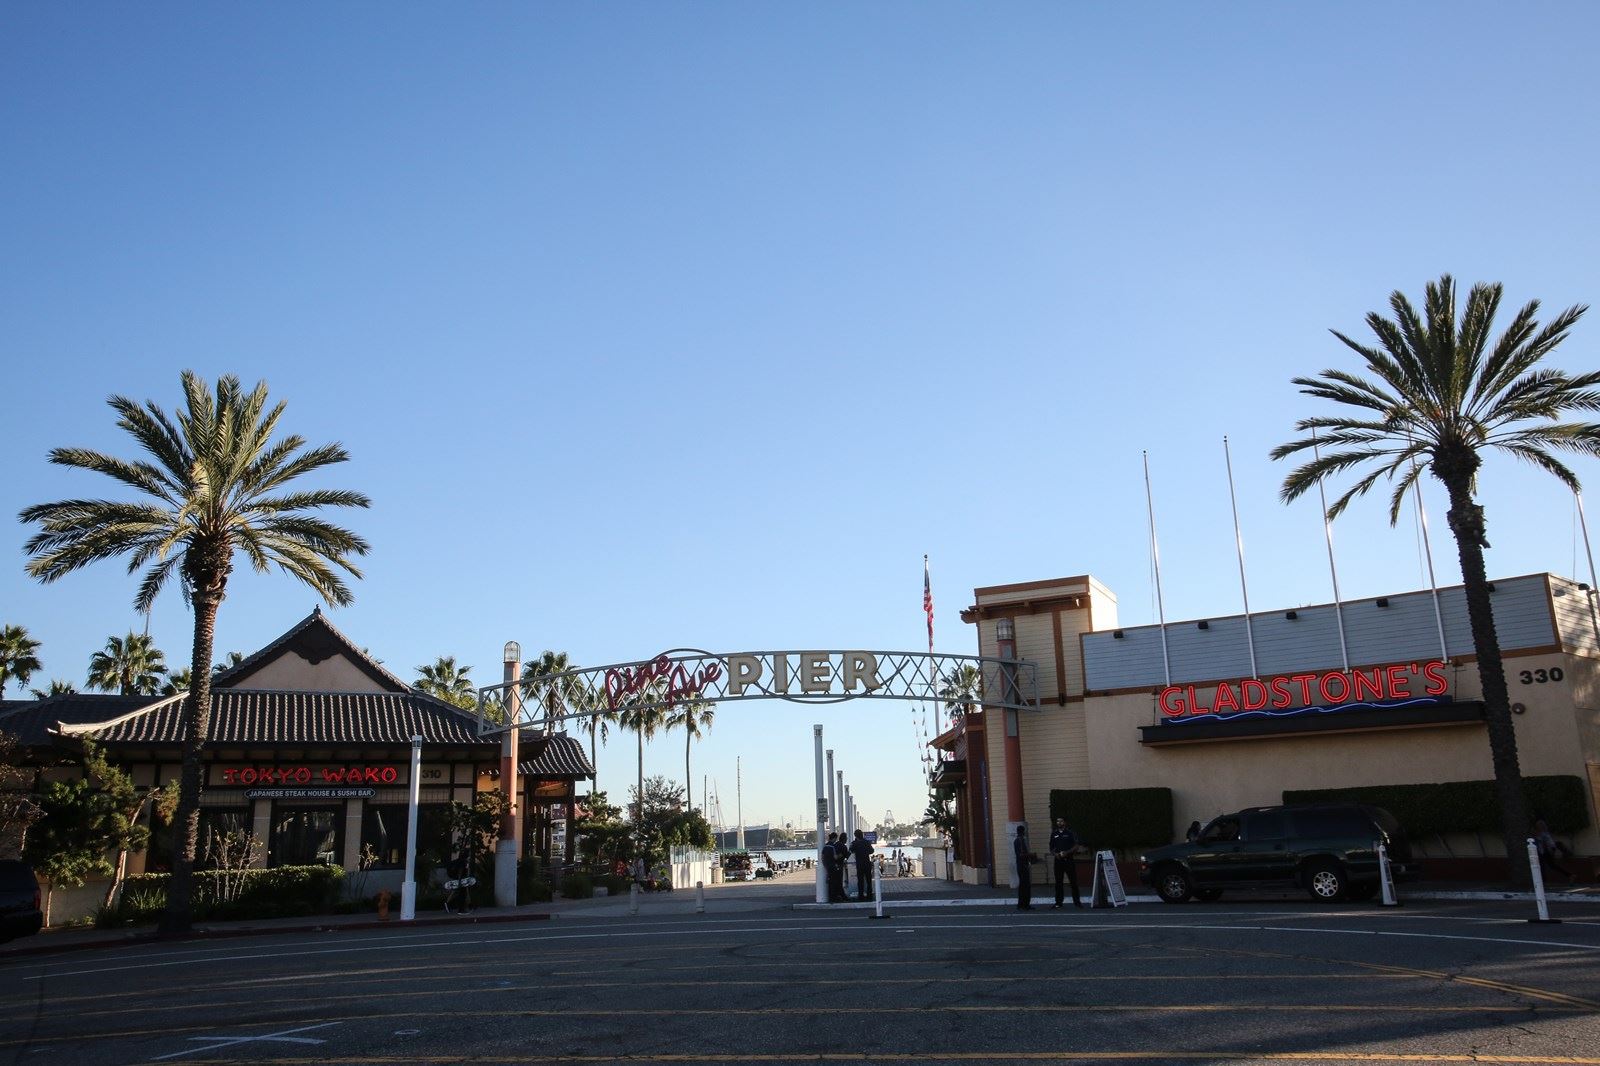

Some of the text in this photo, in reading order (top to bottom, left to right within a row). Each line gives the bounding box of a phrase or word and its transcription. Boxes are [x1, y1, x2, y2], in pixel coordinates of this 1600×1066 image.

[604, 650, 883, 712] Pine Ave PIER
[1519, 667, 1564, 685] 330
[1159, 660, 1449, 717] GLADSTONE'S
[223, 767, 397, 784] TOKYO WAKO
[421, 769, 442, 779] 310
